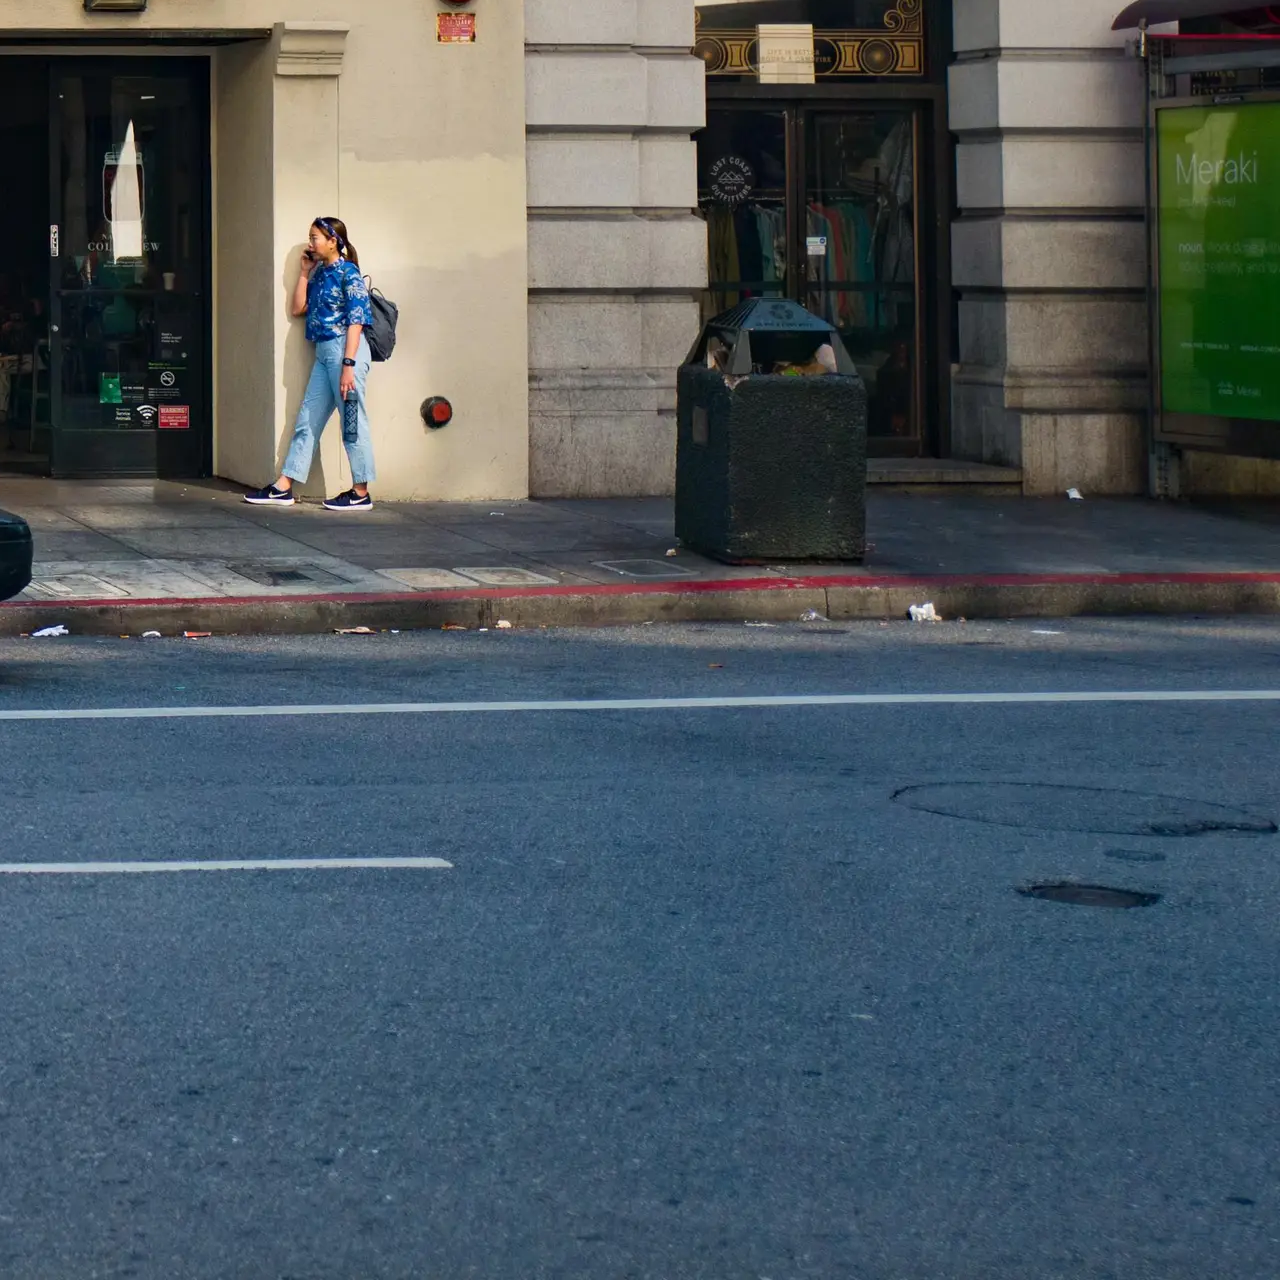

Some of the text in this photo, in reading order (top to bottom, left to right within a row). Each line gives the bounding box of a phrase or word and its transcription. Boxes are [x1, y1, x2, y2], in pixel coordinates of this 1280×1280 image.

[709, 156, 753, 177] LOST COAST
[1176, 149, 1258, 185] Meraki
[711, 183, 753, 203] OUTFITTERS
